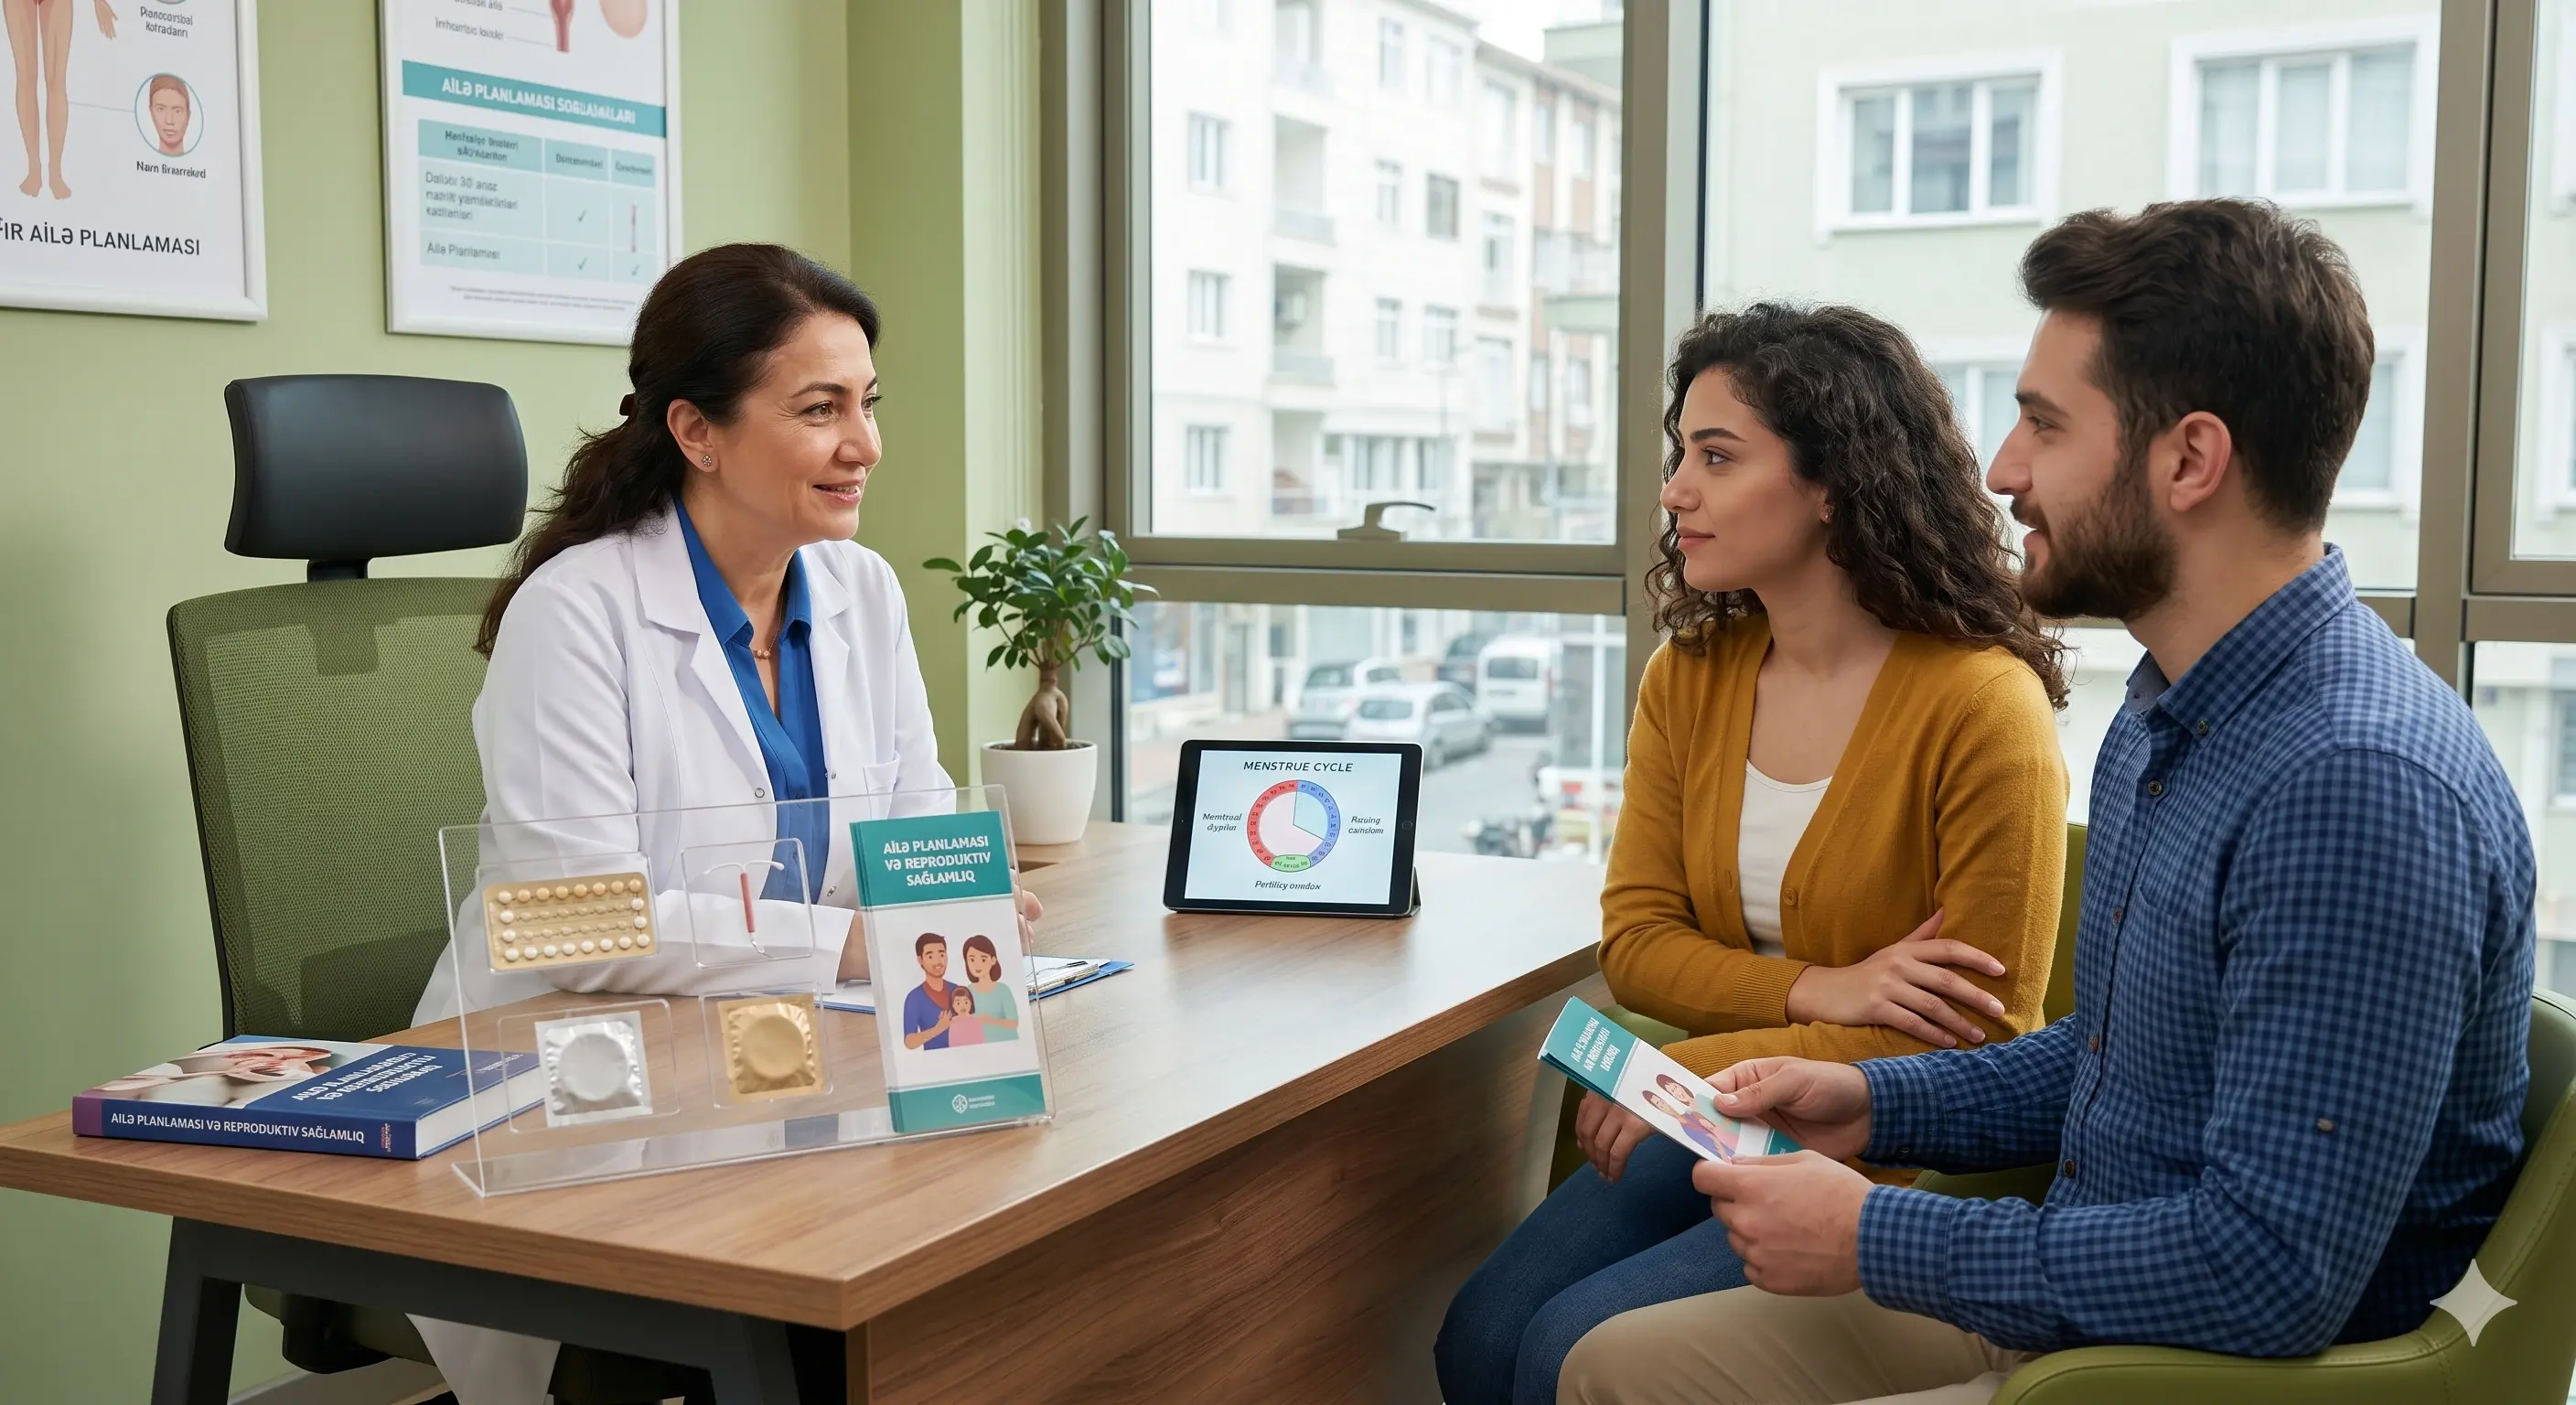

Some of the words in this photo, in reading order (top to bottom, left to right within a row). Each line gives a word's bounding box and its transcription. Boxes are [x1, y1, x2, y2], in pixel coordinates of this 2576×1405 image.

[474, 83, 556, 111] PLANLAMASI
[29, 220, 74, 245] AİLƏ
[80, 229, 199, 256] PLANLAMASI
[1243, 761, 1311, 772] MENSTRUE
[1314, 762, 1354, 773] CYCLE
[912, 835, 989, 852] PLANLAMASI
[885, 859, 902, 871] VƏ
[905, 852, 992, 870] REPRODUKTIV
[907, 870, 976, 886] SAĞLAMLIQ
[111, 1112, 134, 1125] AILƏ
[137, 1114, 204, 1131] PLANLAMASI
[206, 1120, 221, 1132] VƏ
[223, 1121, 300, 1137] REPRODUKTIV
[301, 1125, 365, 1144] SAĞLAMLIQ
